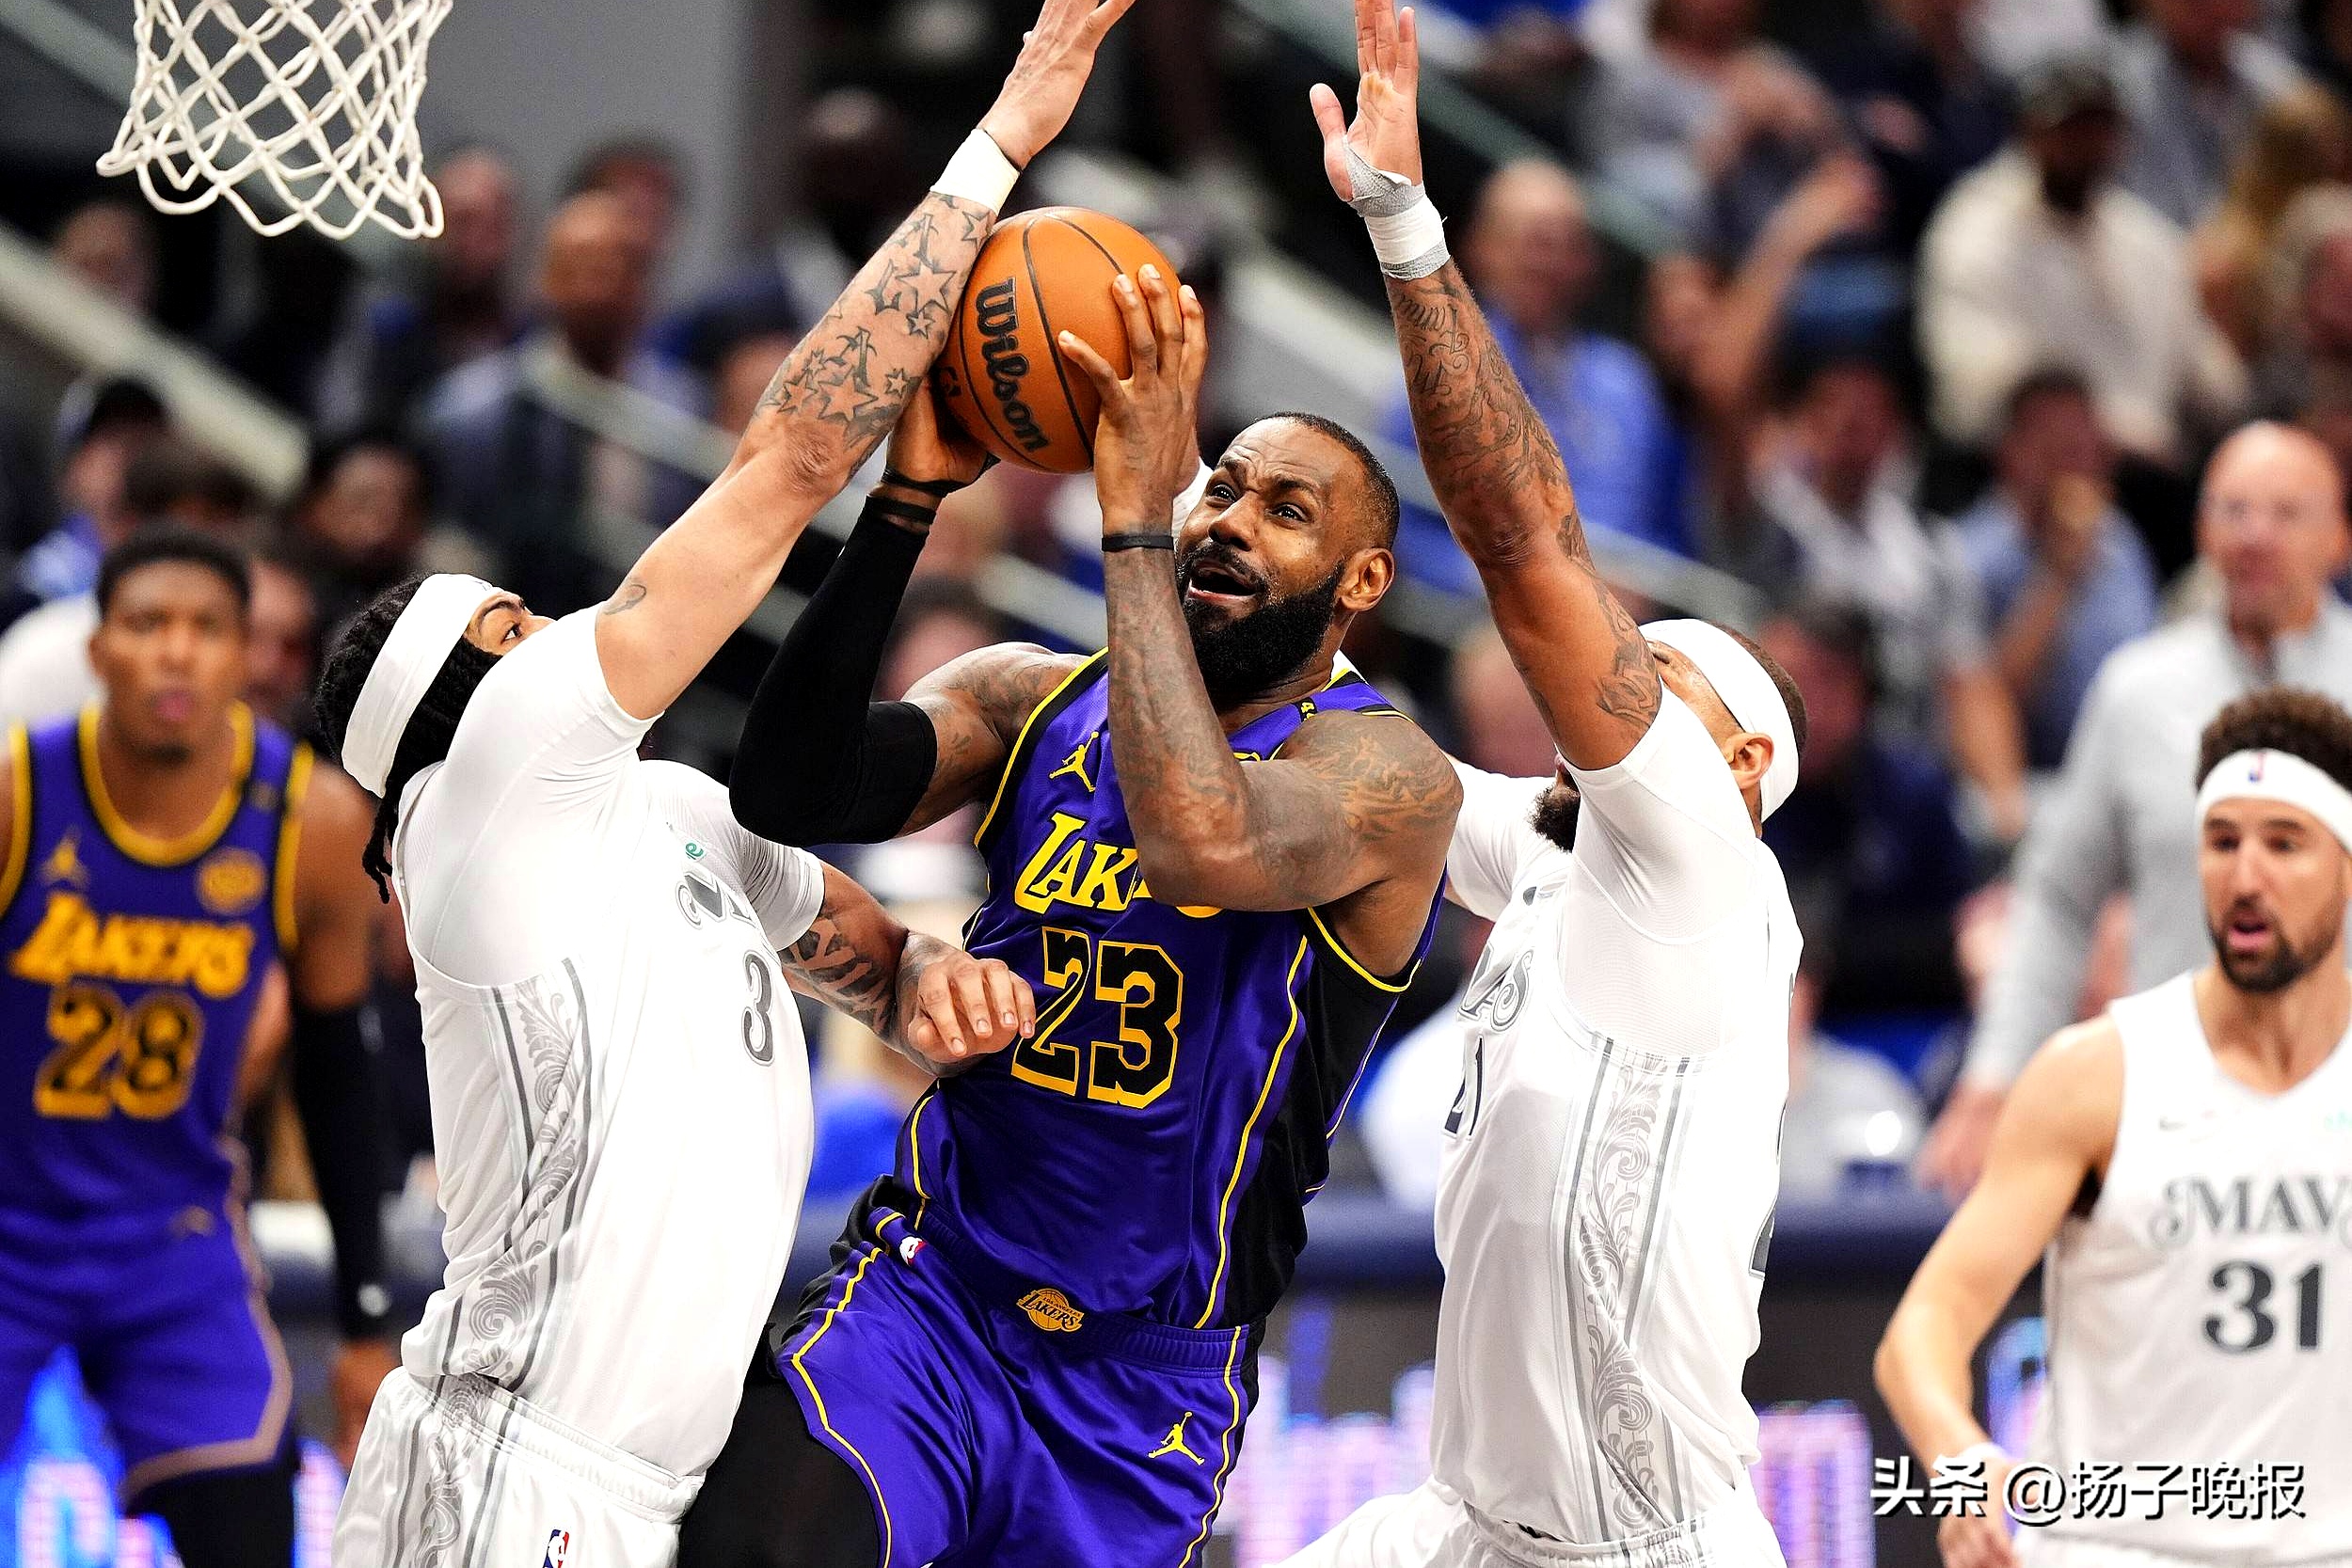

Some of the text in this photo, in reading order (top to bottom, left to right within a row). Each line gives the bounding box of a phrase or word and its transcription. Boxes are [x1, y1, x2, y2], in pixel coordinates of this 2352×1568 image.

[975, 277, 1050, 452] Wilson
[32, 982, 204, 1119] 28
[741, 949, 775, 1067] 3
[1011, 926, 1184, 1109] 23
[1020, 1293, 1079, 1330] LAKERS
[2204, 1258, 2323, 1354] 31
